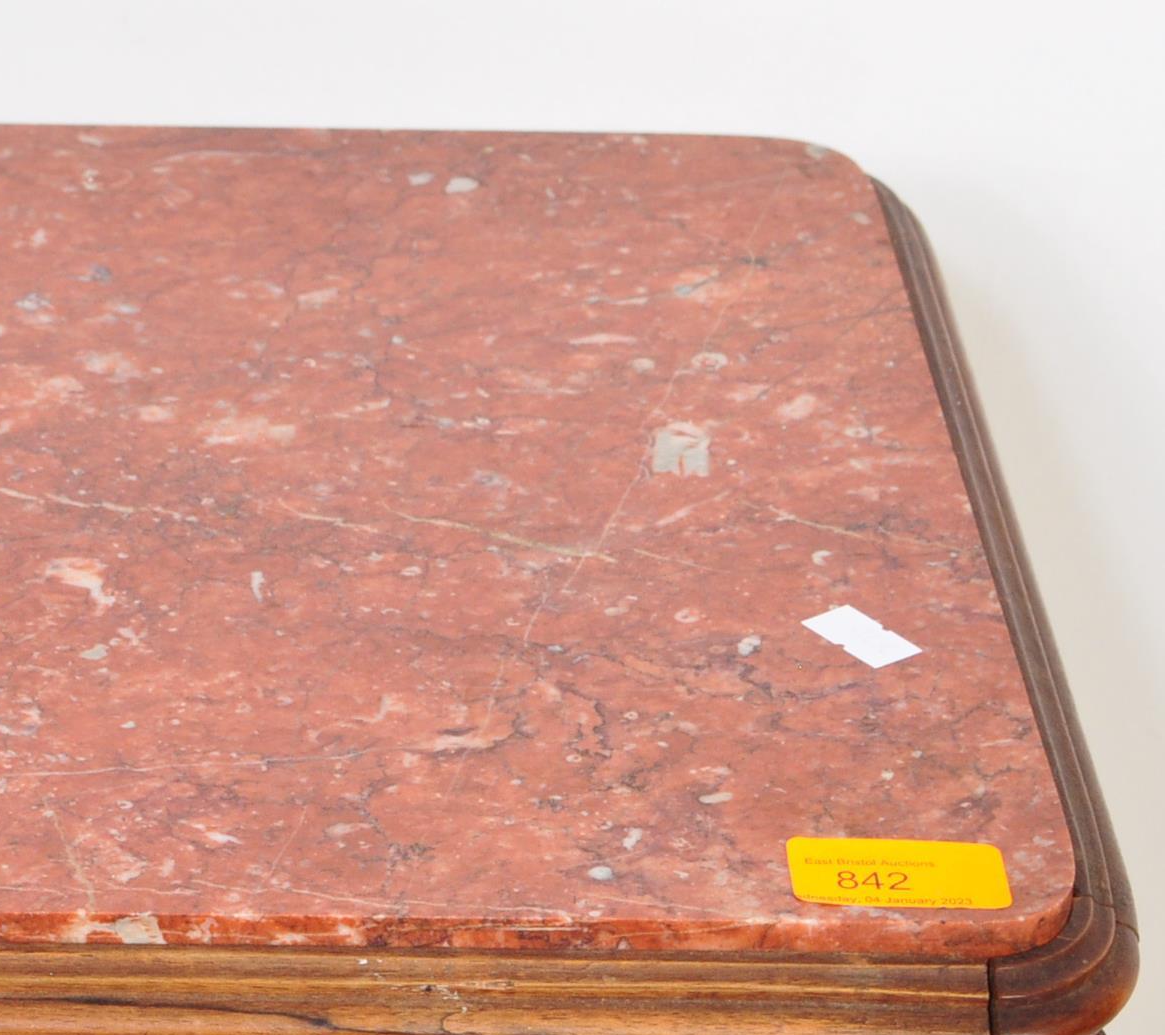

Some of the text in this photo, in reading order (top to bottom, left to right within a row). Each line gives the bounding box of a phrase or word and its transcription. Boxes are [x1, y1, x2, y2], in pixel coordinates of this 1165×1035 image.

[804, 857, 936, 868] East Bristol Auctions
[837, 870, 911, 890] 842
[865, 895, 881, 903] 04
[886, 896, 936, 906] January
